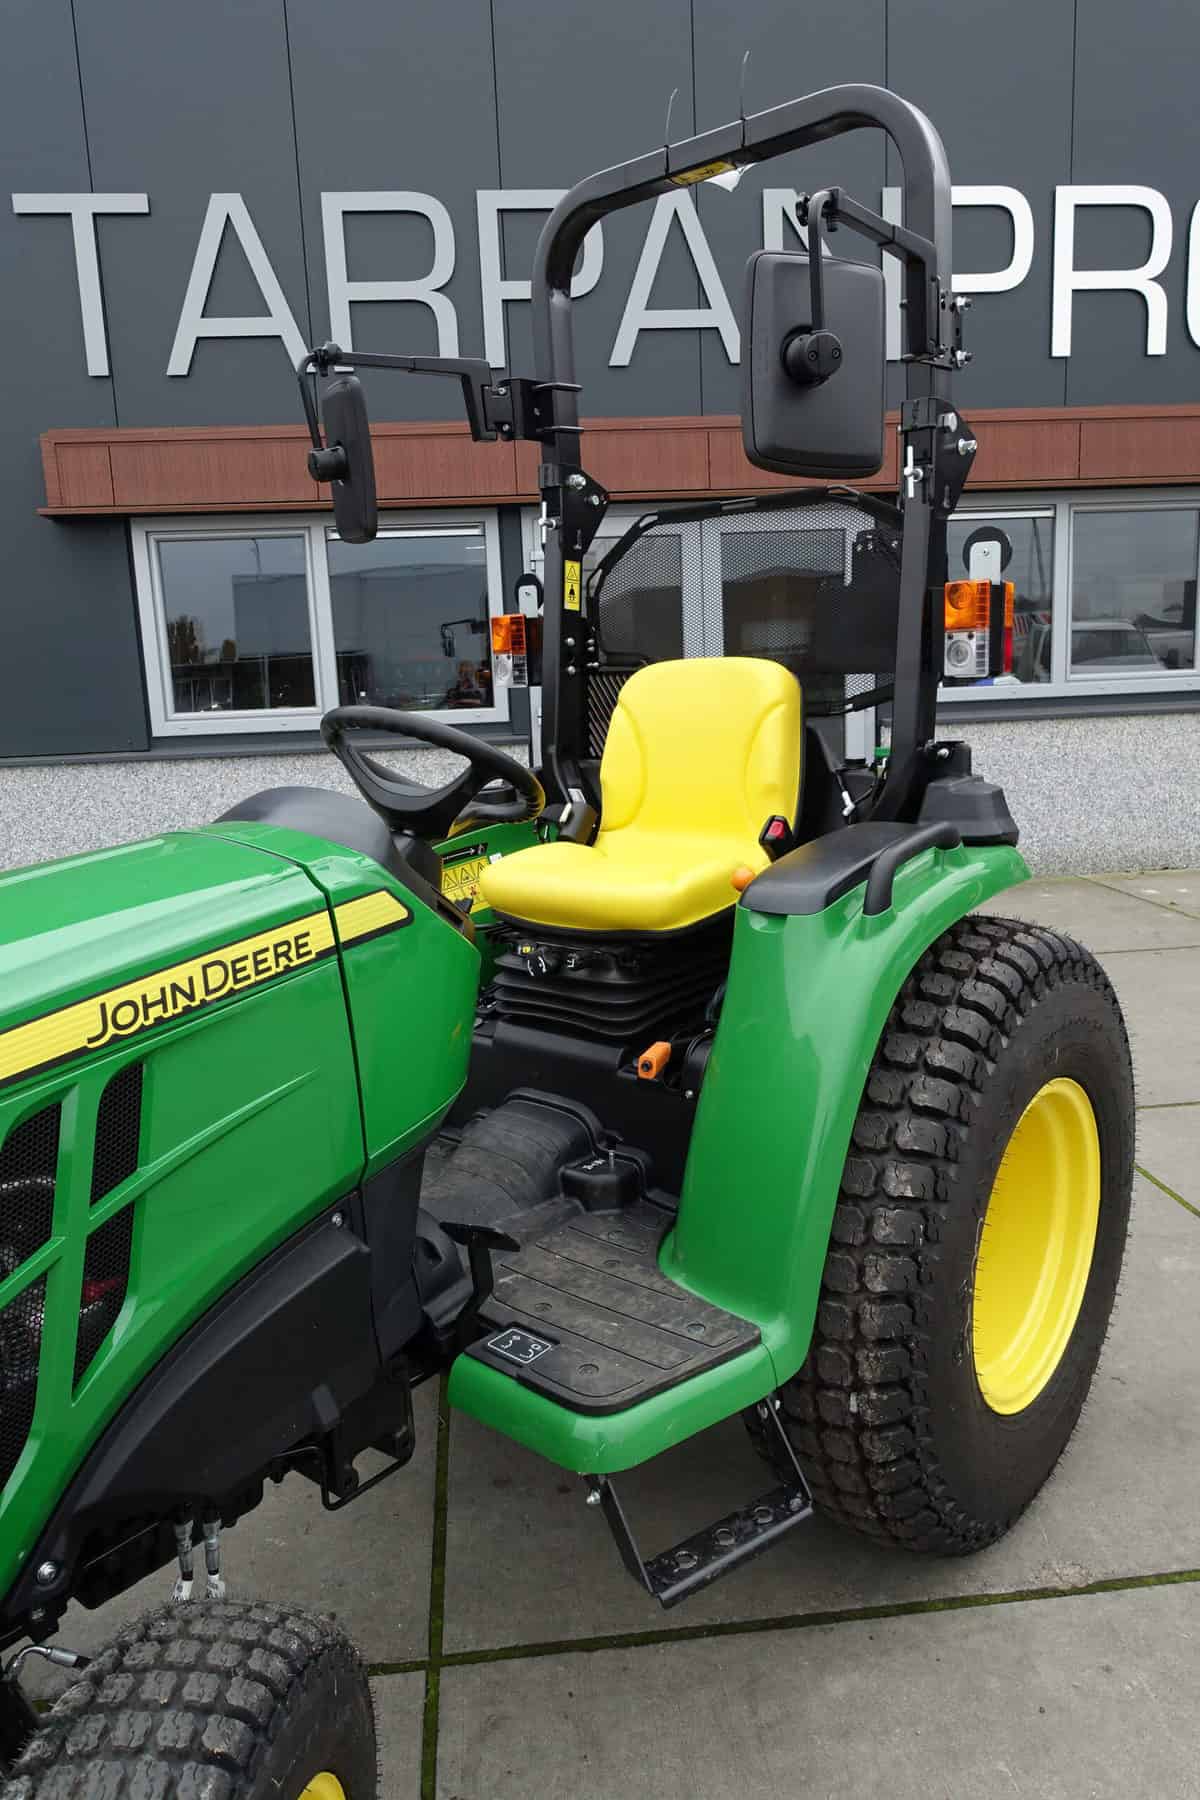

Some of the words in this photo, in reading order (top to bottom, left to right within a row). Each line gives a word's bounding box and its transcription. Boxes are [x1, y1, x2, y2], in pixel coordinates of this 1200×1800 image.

[950, 184, 1200, 357] PR
[87, 975, 196, 1045] JOHN
[201, 931, 313, 998] DEERE
